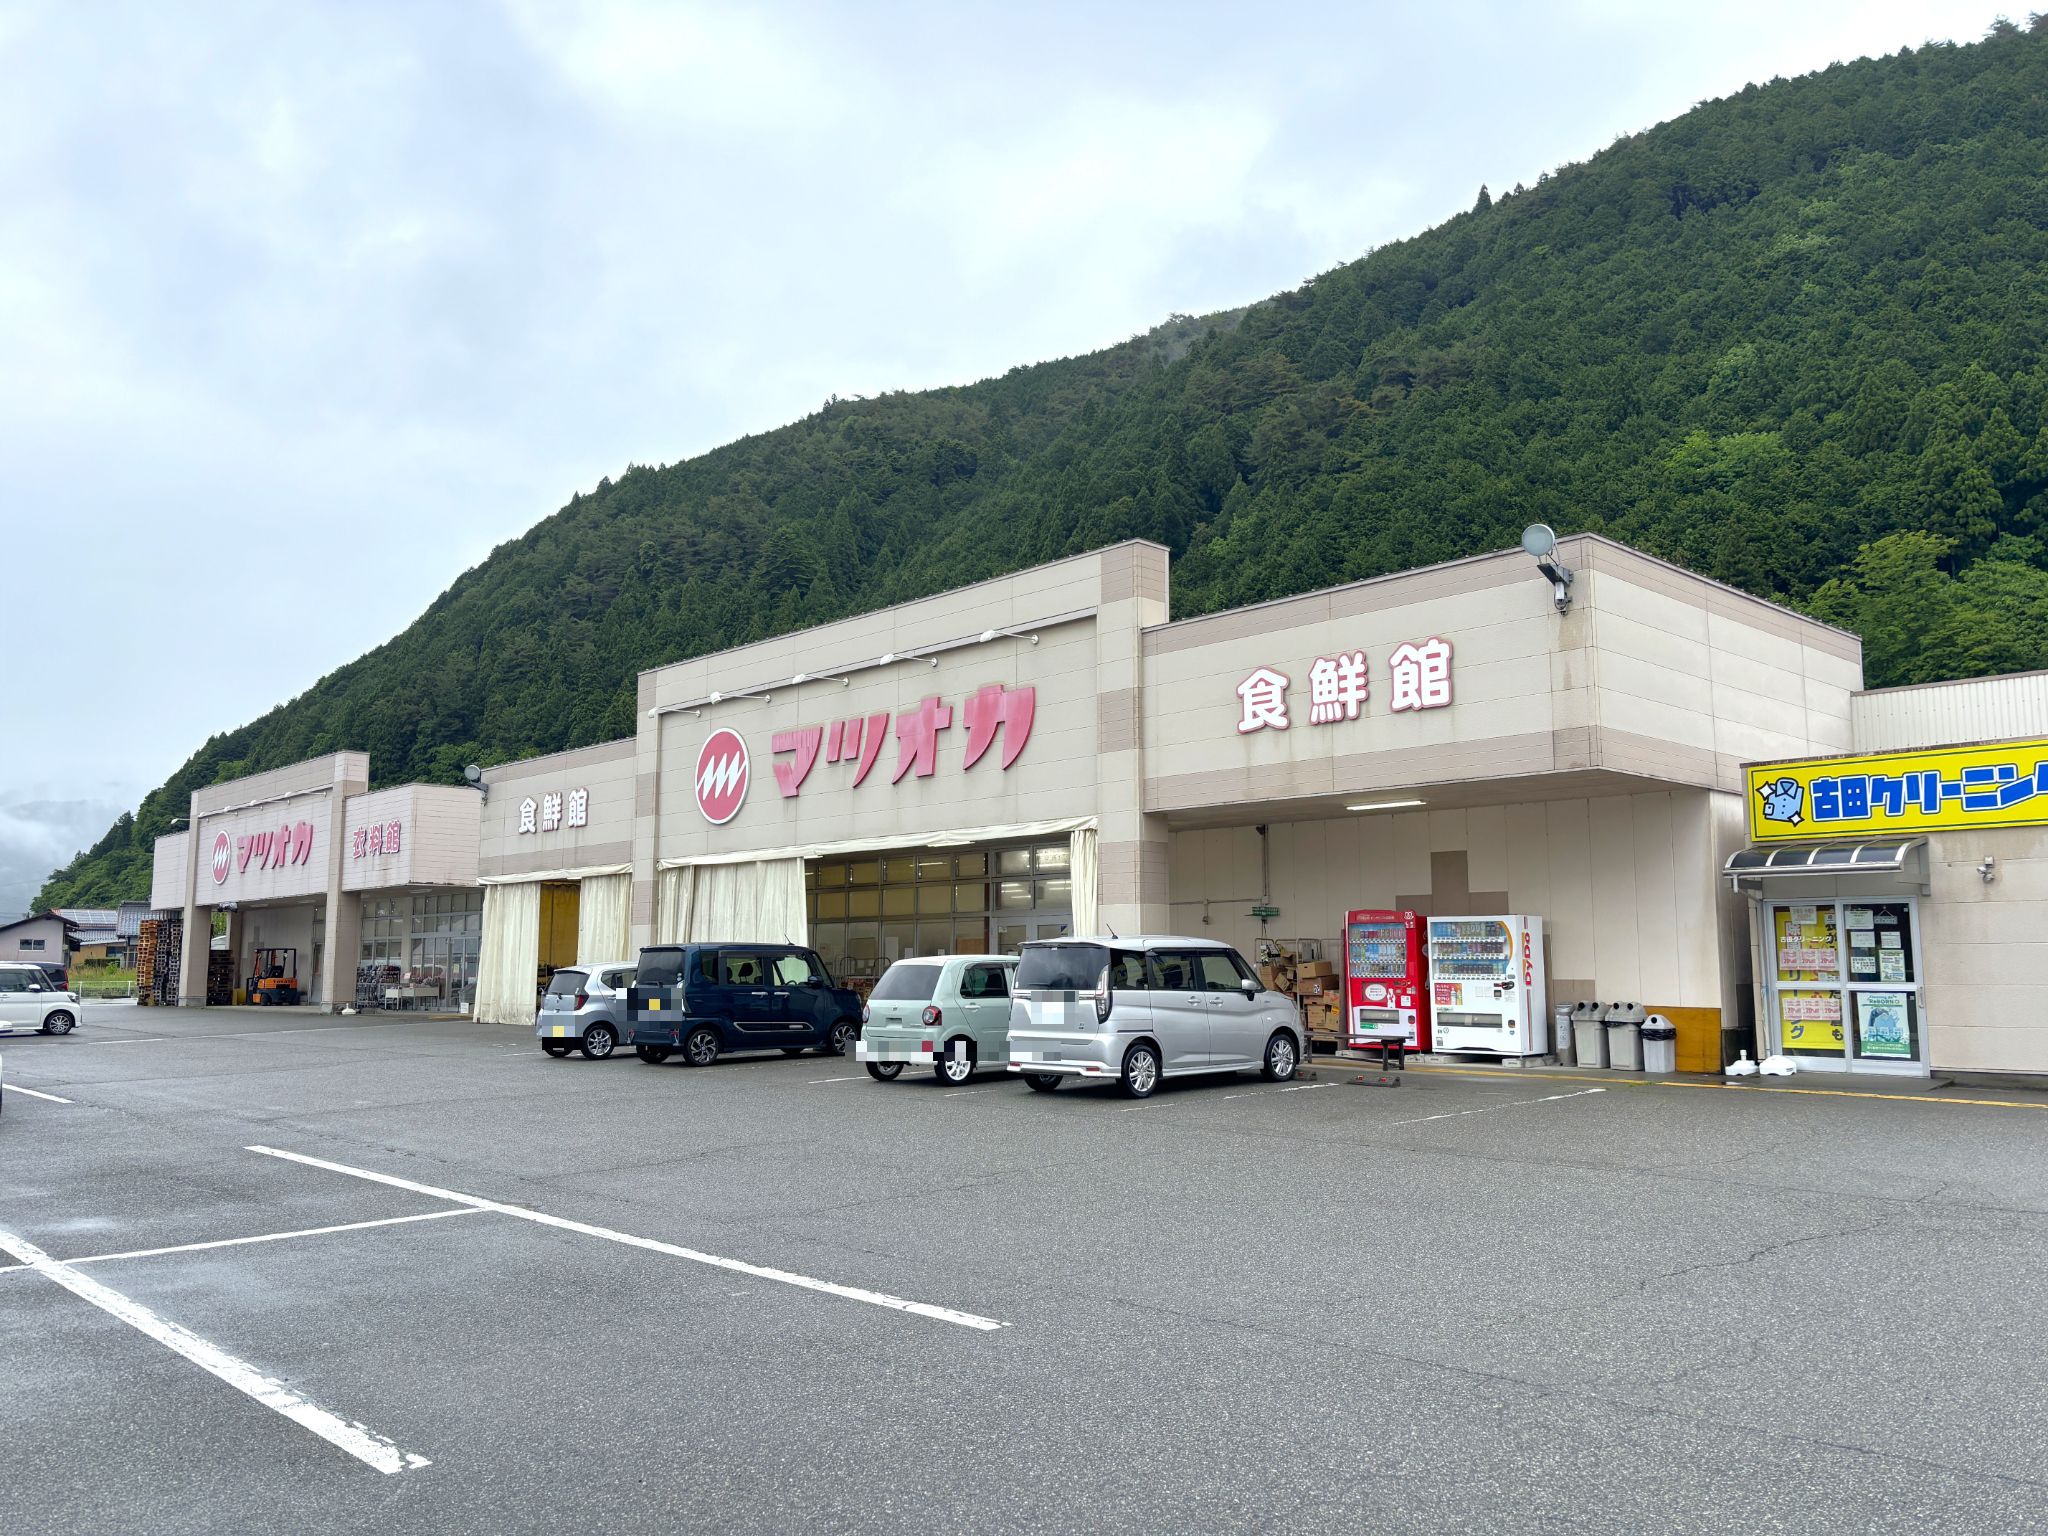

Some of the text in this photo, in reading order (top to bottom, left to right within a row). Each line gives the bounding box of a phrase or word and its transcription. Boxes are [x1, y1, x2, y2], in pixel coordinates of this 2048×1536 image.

[1237, 637, 1453, 733] 食鮮館
[772, 684, 1035, 798] マツオカ
[519, 787, 588, 834] 食鮮館
[1811, 761, 2048, 822] 古田クリーニン
[237, 822, 313, 873] マツオカ
[353, 820, 400, 859] 衣料館
[1524, 932, 1533, 986] DyDo
